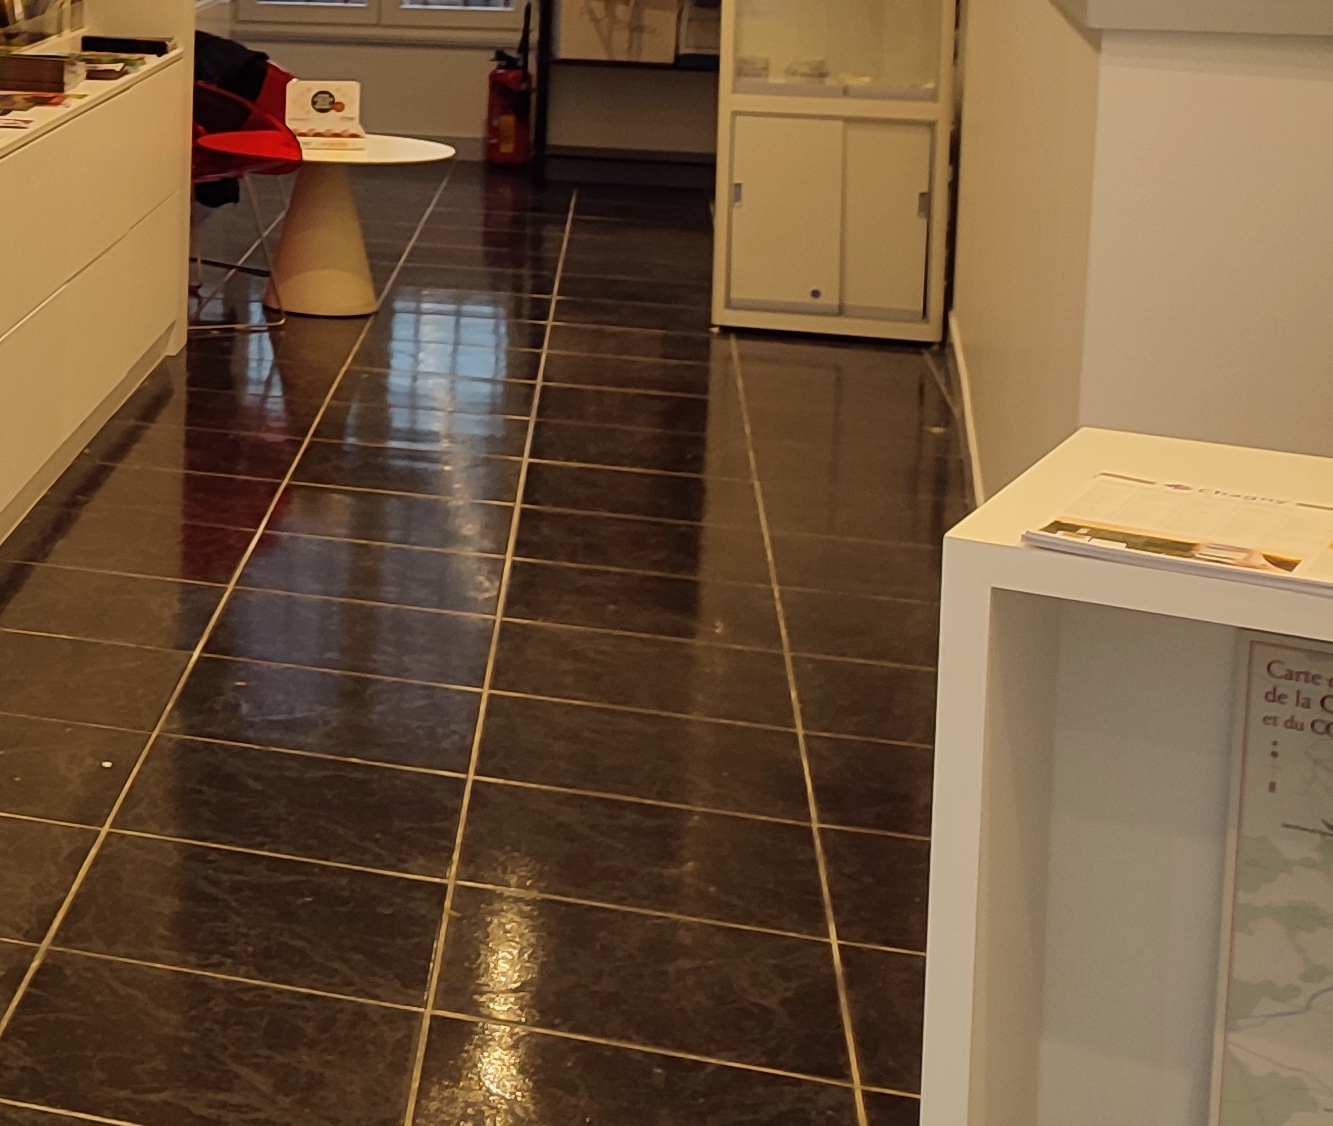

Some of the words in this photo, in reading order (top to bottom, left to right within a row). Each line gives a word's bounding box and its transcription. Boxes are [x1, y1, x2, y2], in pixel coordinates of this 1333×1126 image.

[1266, 659, 1322, 686] Carte
[1264, 686, 1288, 705] de
[1295, 689, 1311, 709] la
[1262, 715, 1278, 727] et
[1283, 715, 1304, 732] du
